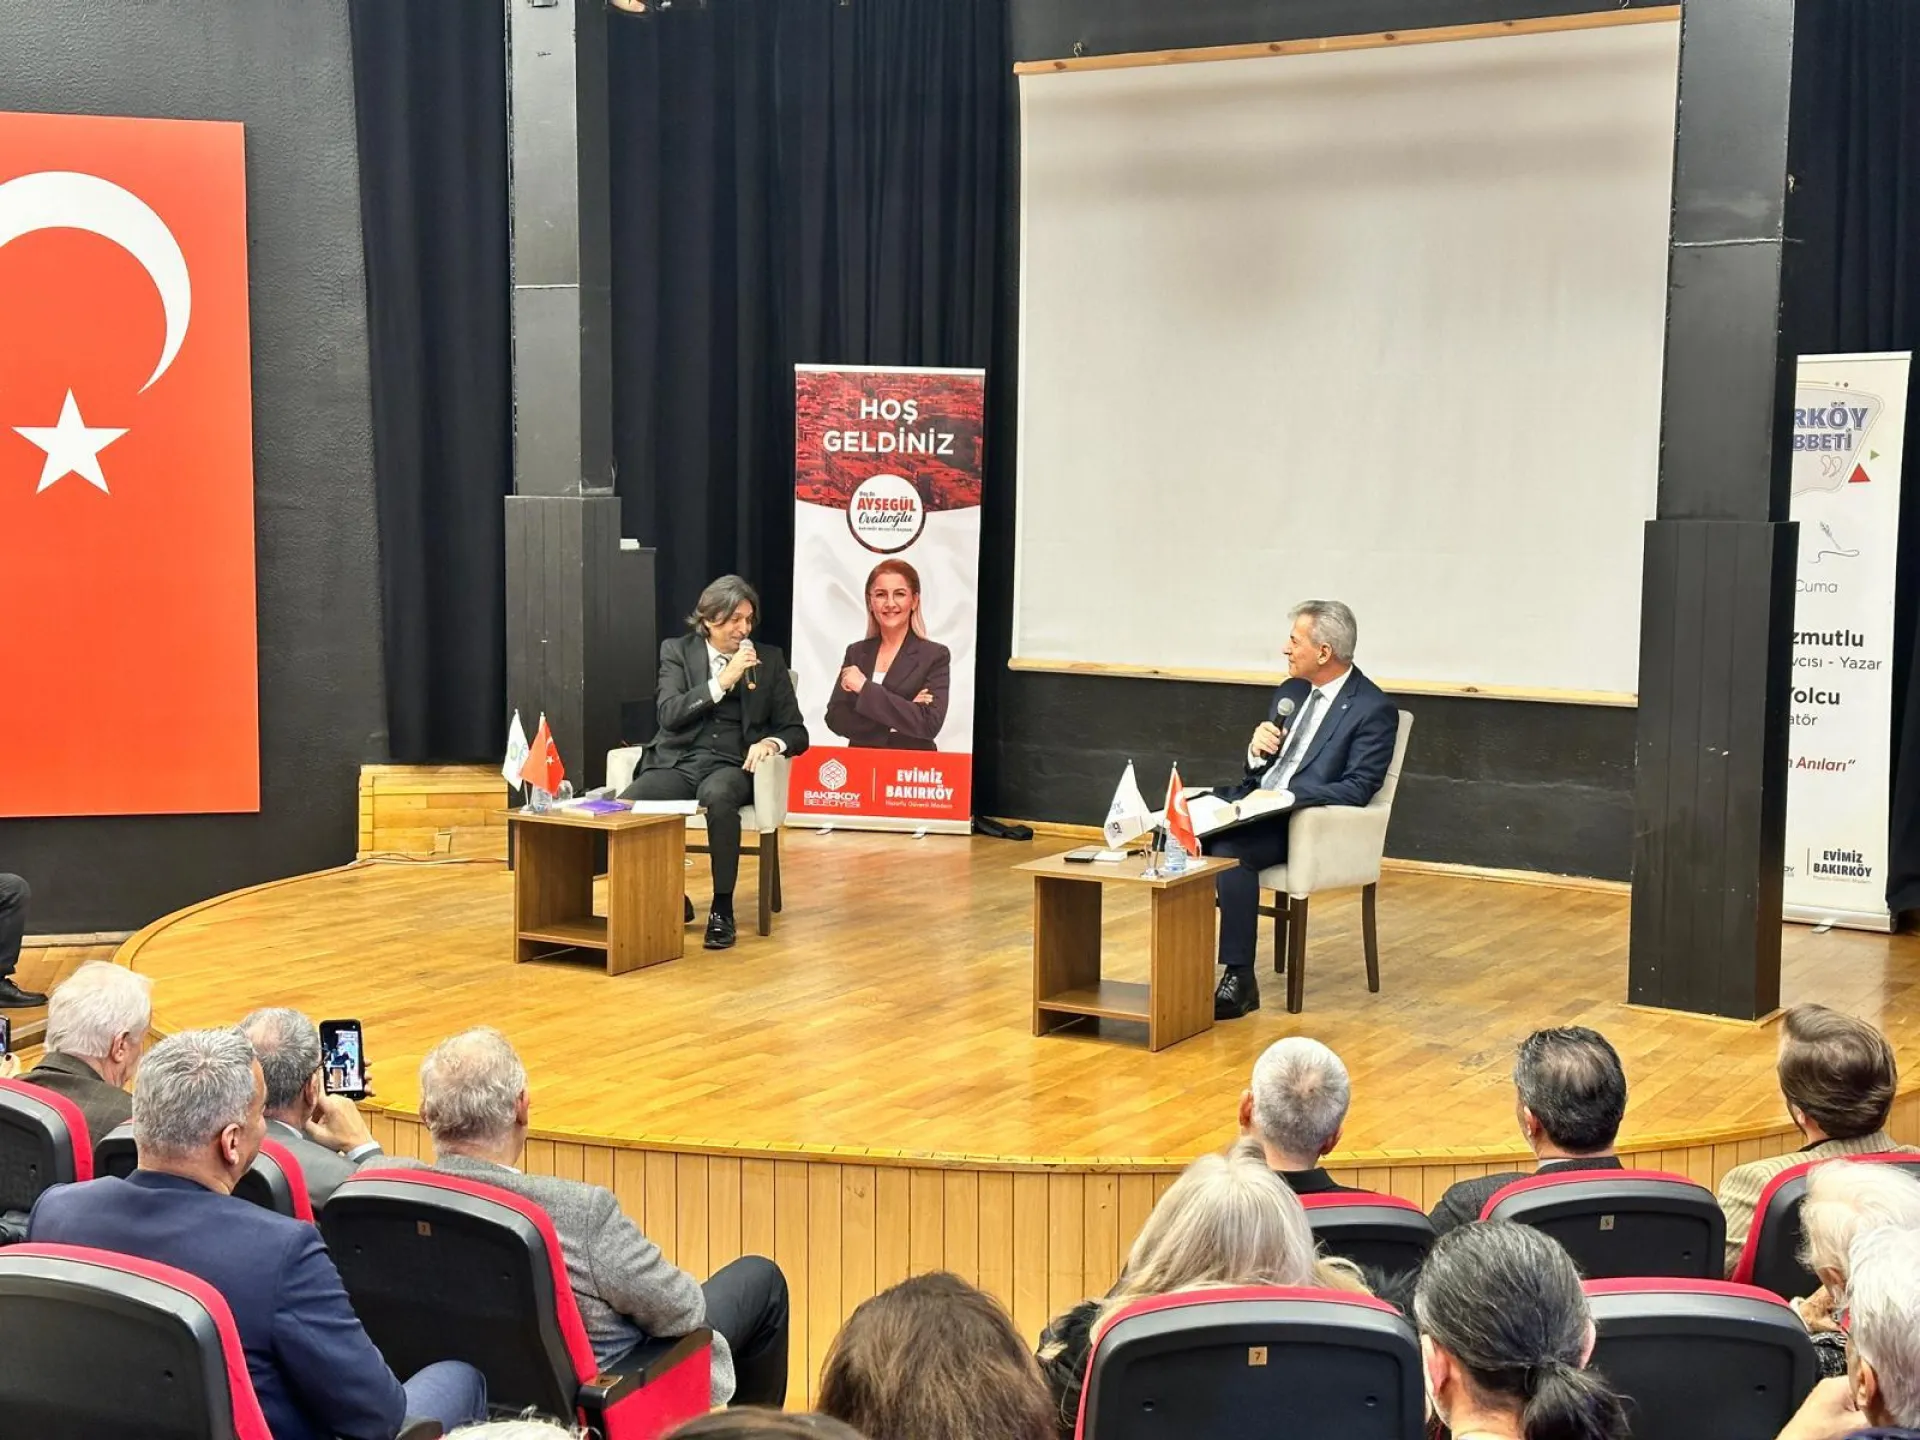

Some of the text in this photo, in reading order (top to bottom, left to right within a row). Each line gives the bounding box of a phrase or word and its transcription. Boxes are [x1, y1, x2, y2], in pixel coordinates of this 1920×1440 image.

[860, 399, 919, 424] HOŞ
[823, 427, 955, 455] GELDİNİZ
[857, 496, 916, 513] AYŞEGÜL
[1795, 579, 1838, 593] Cuma
[1840, 656, 1882, 670] Yazar
[897, 766, 943, 784] EVİMİZ
[885, 784, 954, 801] BAKIRKÖY
[1823, 848, 1863, 863] EVİMİZ
[1813, 863, 1872, 877] BAKIRKÖY
[1254, 1351, 1261, 1362] 7
